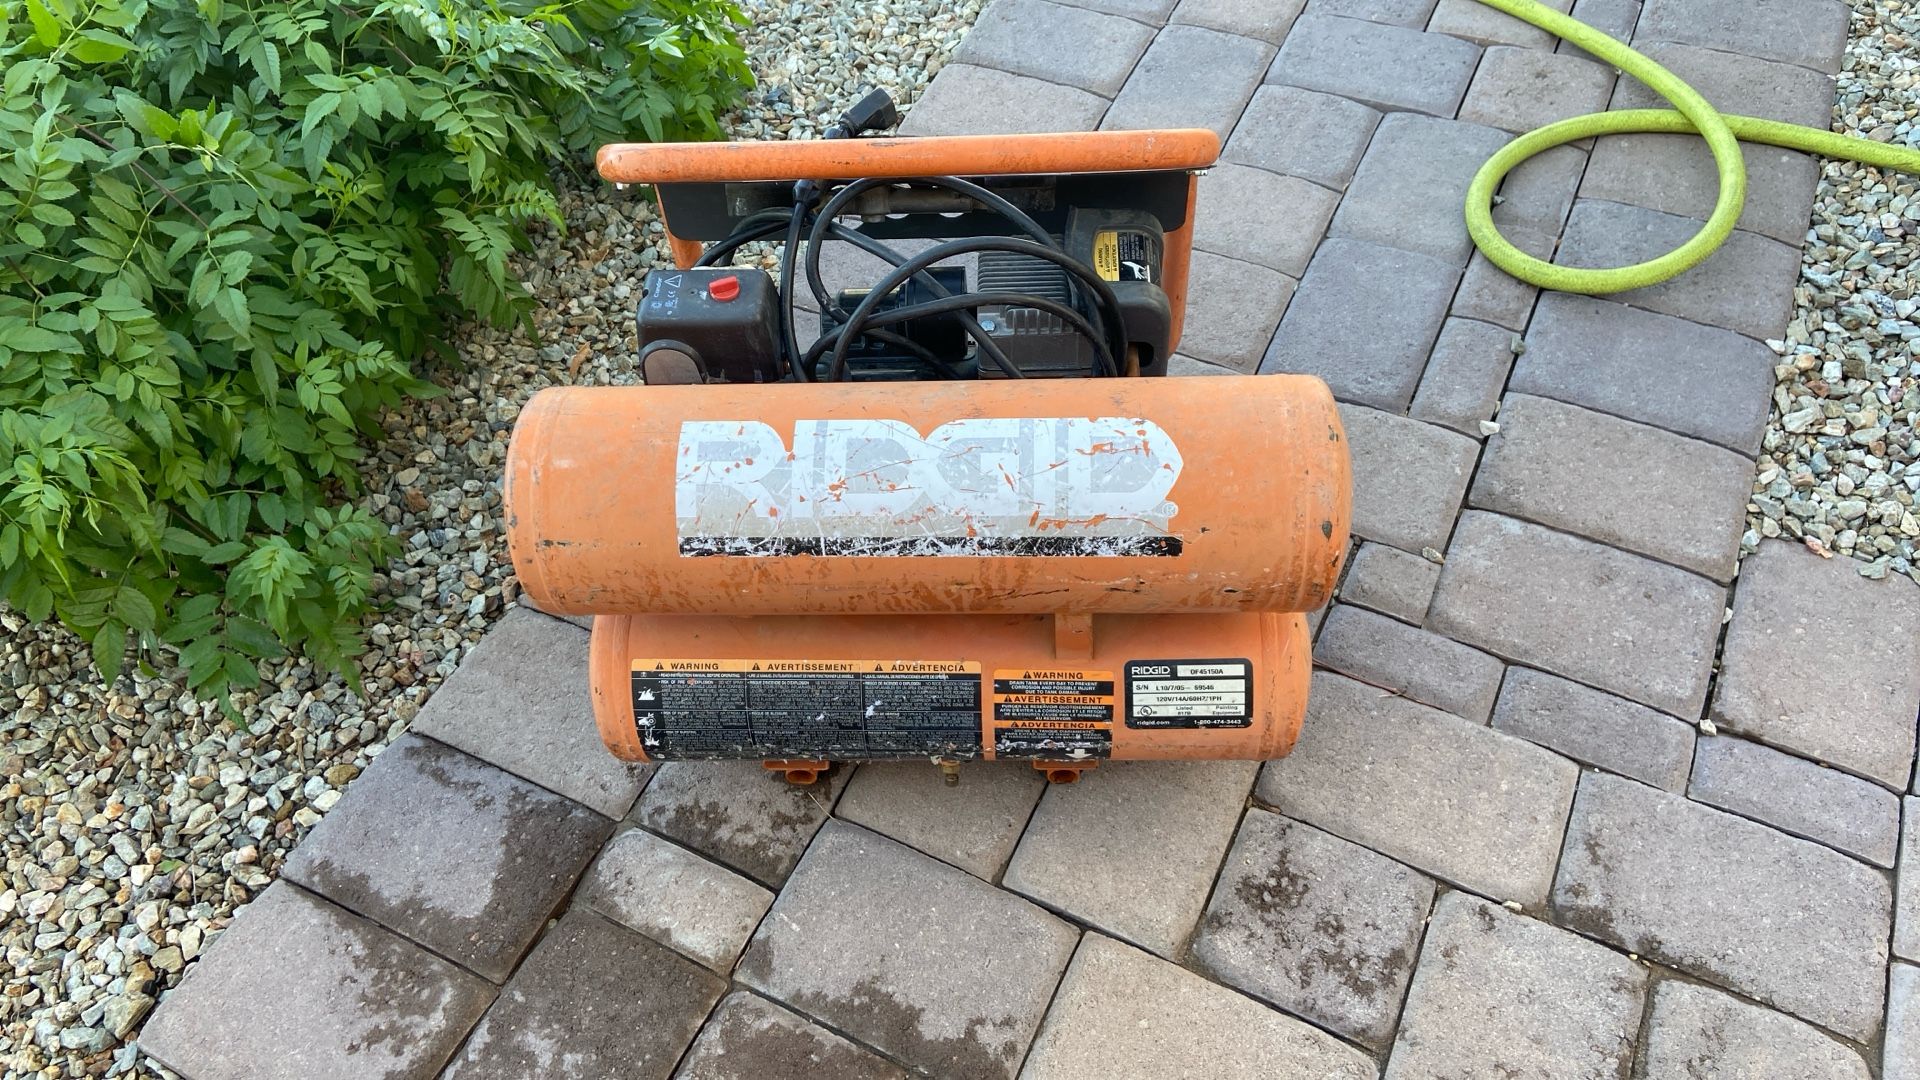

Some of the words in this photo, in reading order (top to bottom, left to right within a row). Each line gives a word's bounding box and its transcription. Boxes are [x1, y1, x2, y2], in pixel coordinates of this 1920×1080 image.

[676, 416, 1184, 519] RIDGID
[671, 662, 719, 670] WARNING
[767, 663, 853, 671] AVERTISSEMENT
[890, 664, 965, 672] ADVERTENCIA
[1131, 666, 1171, 675] RIDGID
[1033, 671, 1084, 680] WARNING
[1014, 695, 1103, 704] AVERTISSEMENT
